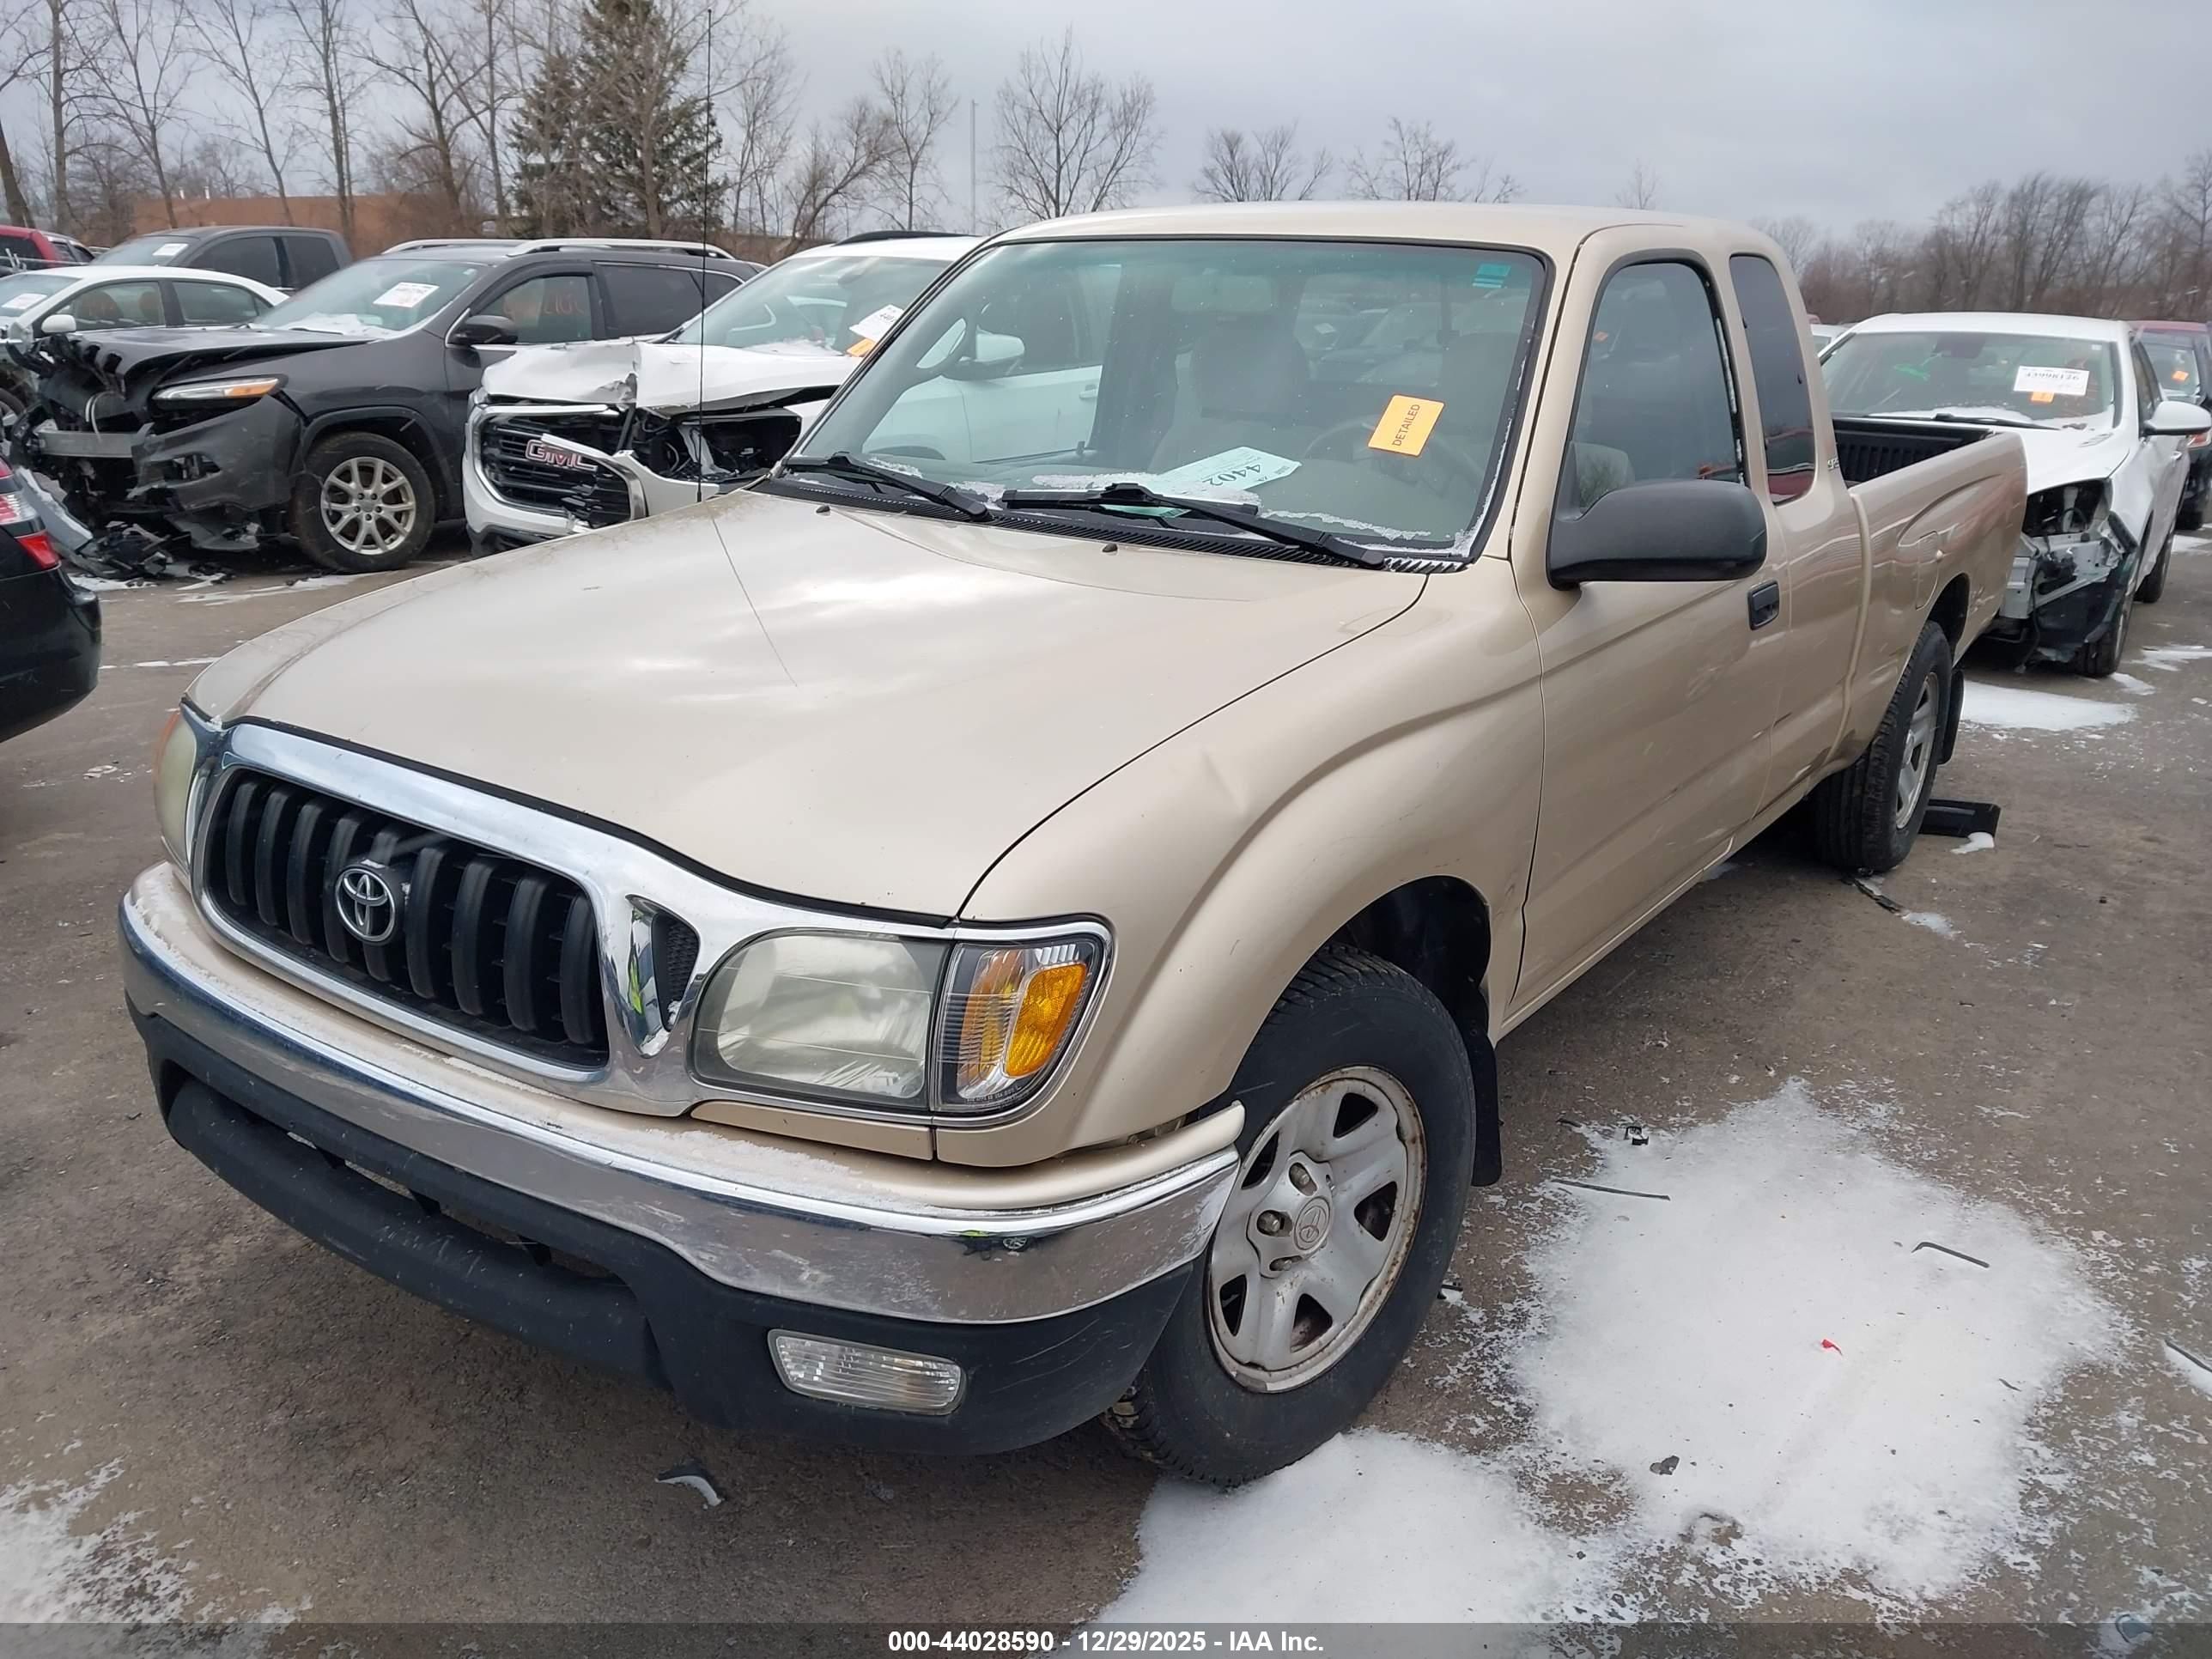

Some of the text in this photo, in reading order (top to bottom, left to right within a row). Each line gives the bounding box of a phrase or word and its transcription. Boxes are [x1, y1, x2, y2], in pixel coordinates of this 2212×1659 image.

[1392, 404, 1421, 447] DETAILED
[526, 439, 599, 471] GMC
[1202, 464, 1263, 487] 4402
